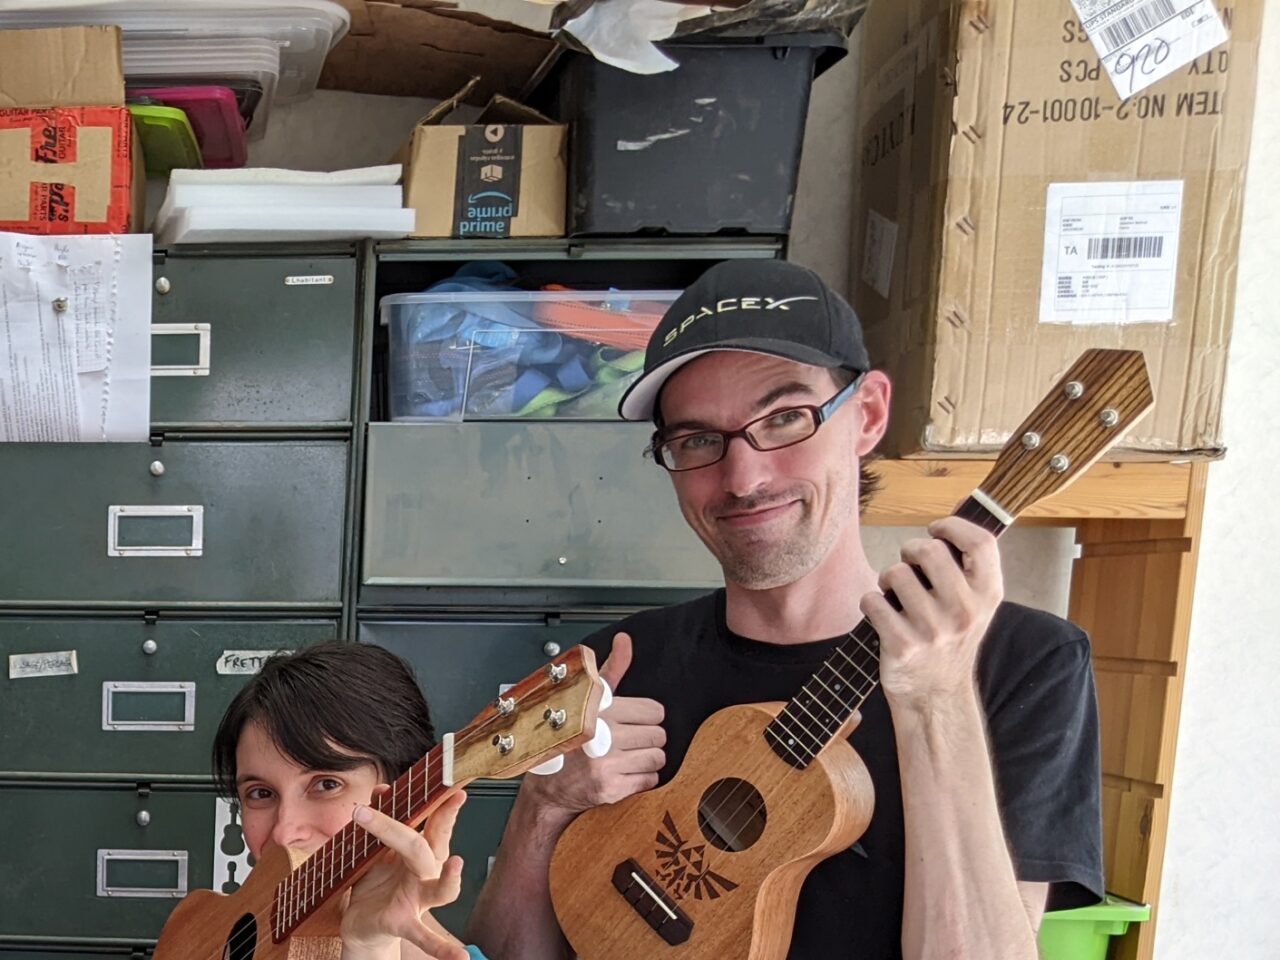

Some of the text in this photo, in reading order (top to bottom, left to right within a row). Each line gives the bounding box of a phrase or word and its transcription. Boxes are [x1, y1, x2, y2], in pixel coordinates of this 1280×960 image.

[1059, 60, 1100, 83] PCS
[1176, 91, 1222, 117] TEM
[468, 202, 513, 218] prime
[460, 218, 505, 235] prime
[1064, 245, 1078, 256] TA
[663, 296, 818, 348] SPACEX
[224, 654, 265, 669] FRETT
